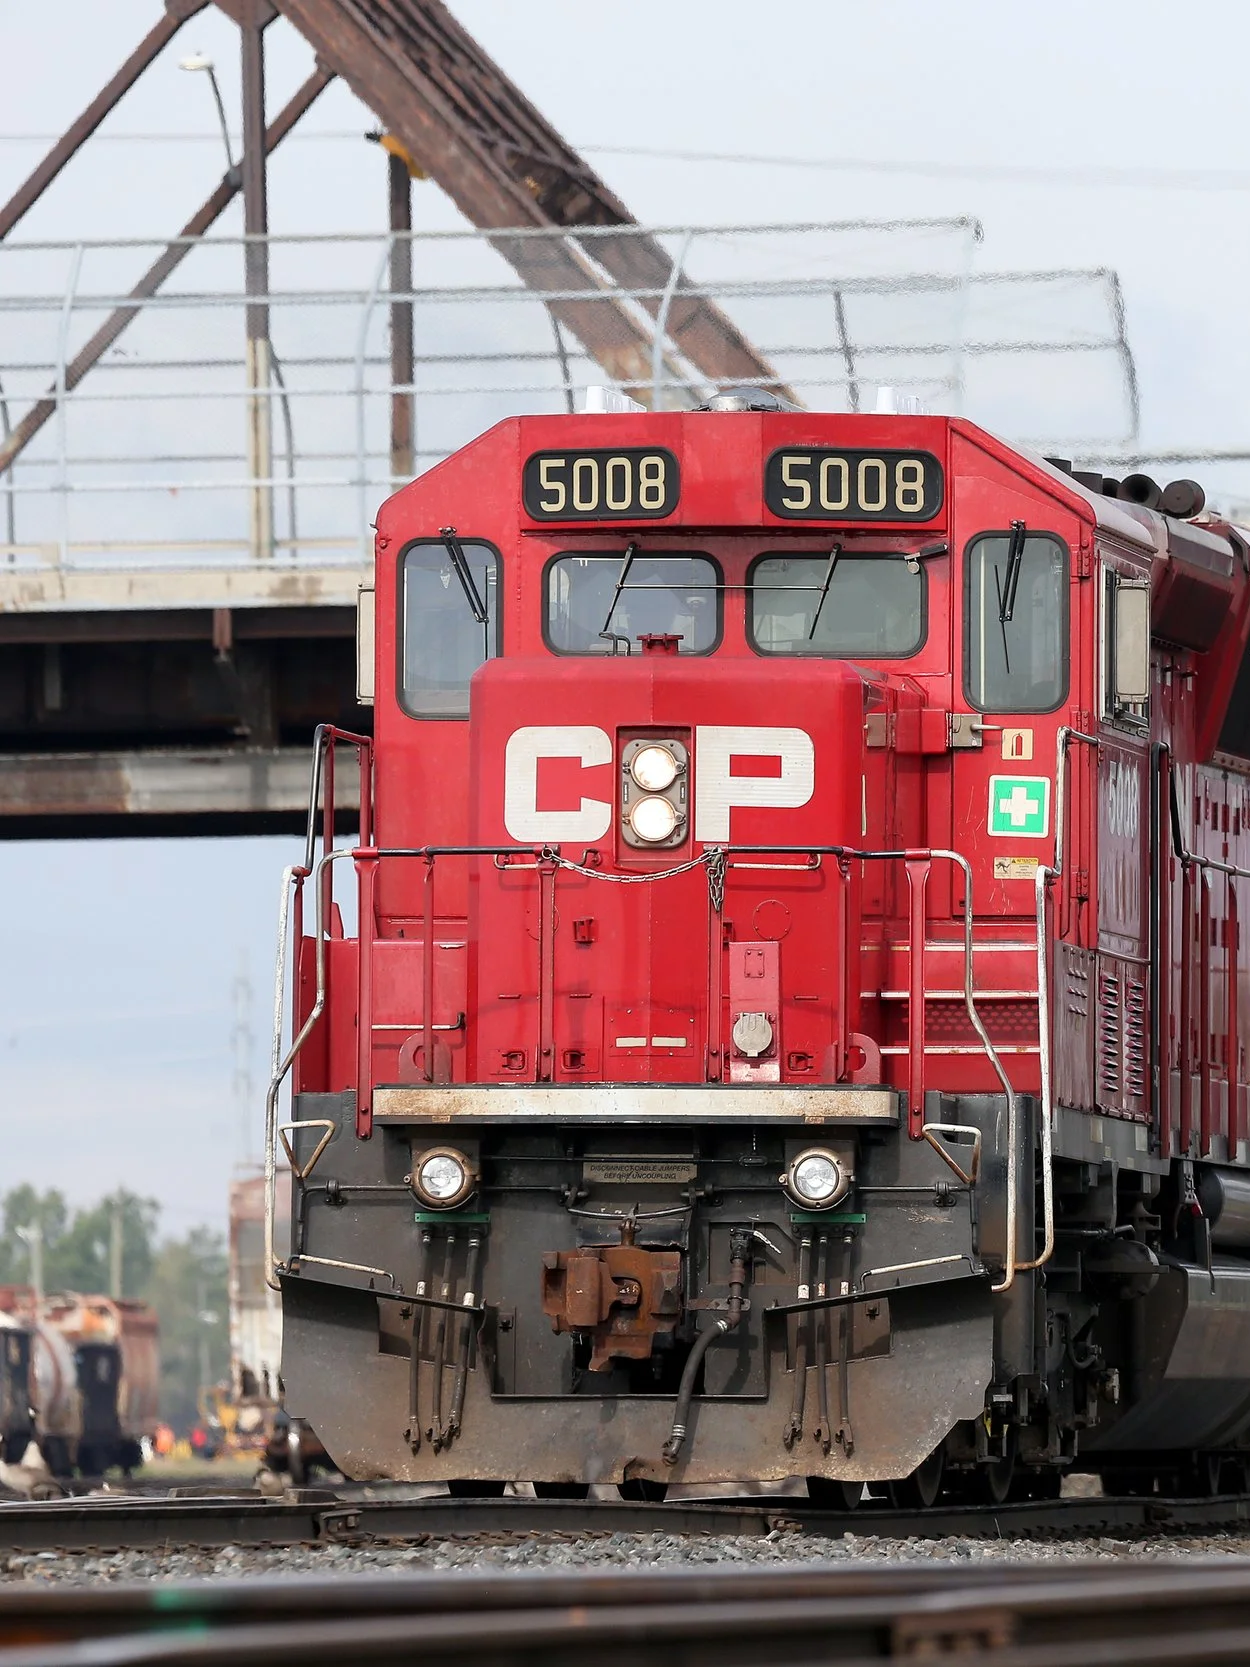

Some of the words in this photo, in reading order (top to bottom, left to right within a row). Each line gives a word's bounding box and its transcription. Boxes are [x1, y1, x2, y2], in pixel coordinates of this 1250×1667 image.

[540, 455, 665, 513] 5008
[781, 456, 924, 513] 5008
[504, 725, 815, 843] CP
[1108, 760, 1139, 838] 5008
[632, 1172, 677, 1180] UNCOUPLING
